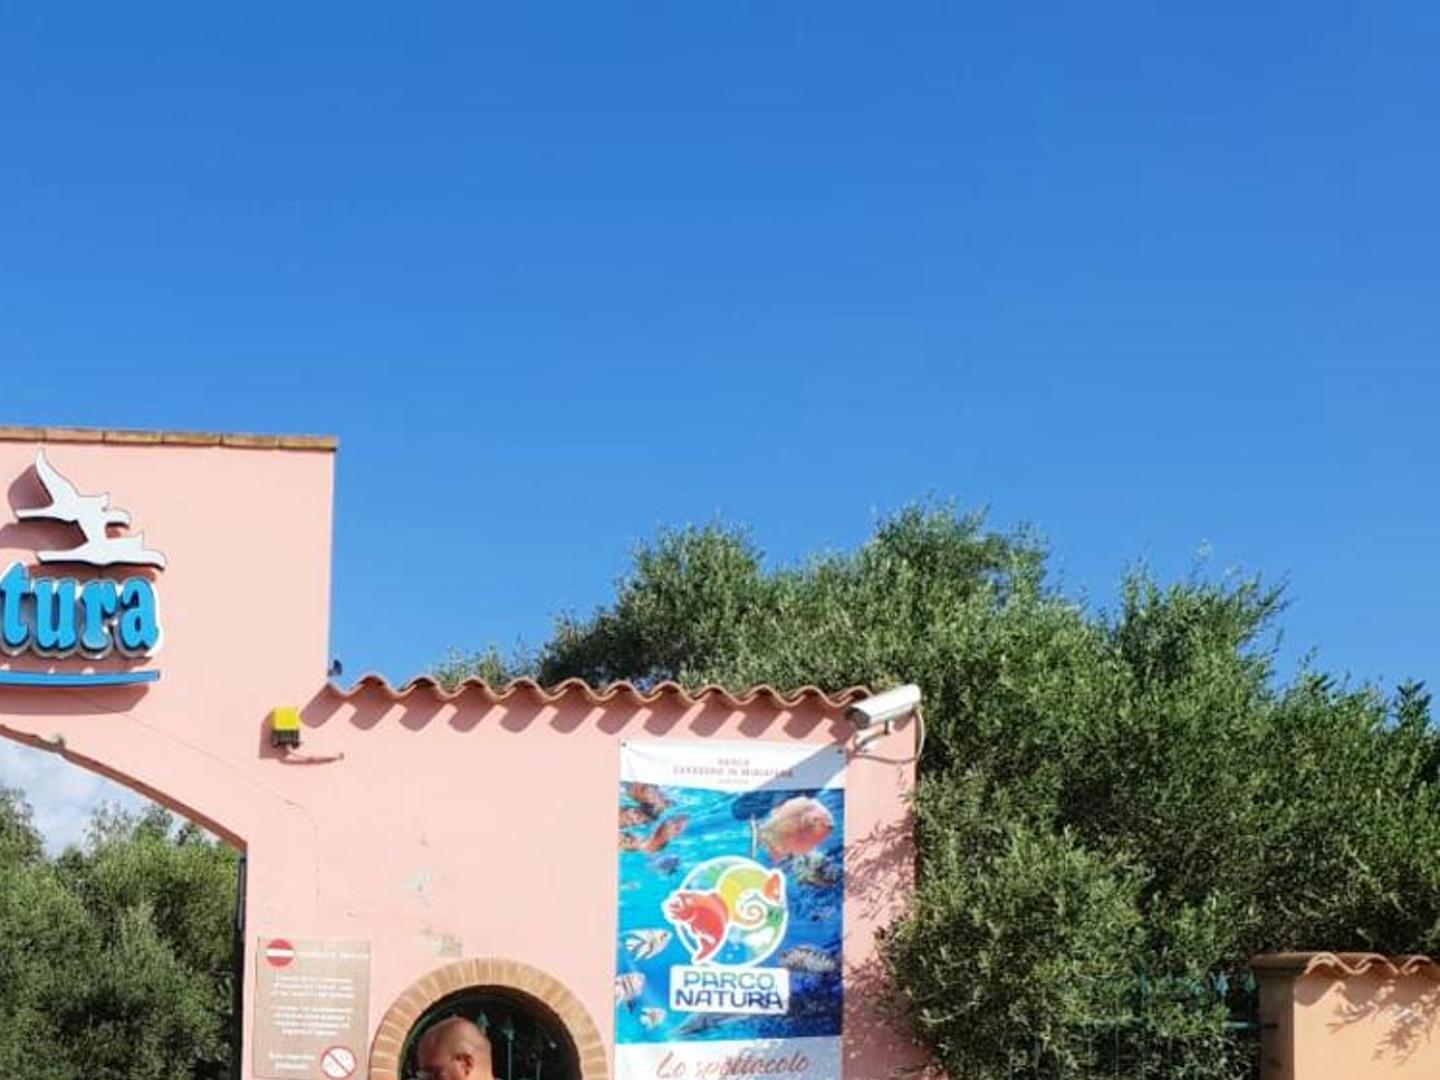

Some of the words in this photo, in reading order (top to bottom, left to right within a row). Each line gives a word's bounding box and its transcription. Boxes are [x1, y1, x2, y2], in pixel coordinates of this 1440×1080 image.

[683, 970, 775, 991] PARCO
[675, 988, 783, 1009] NATURA
[656, 1050, 686, 1078] Lo
